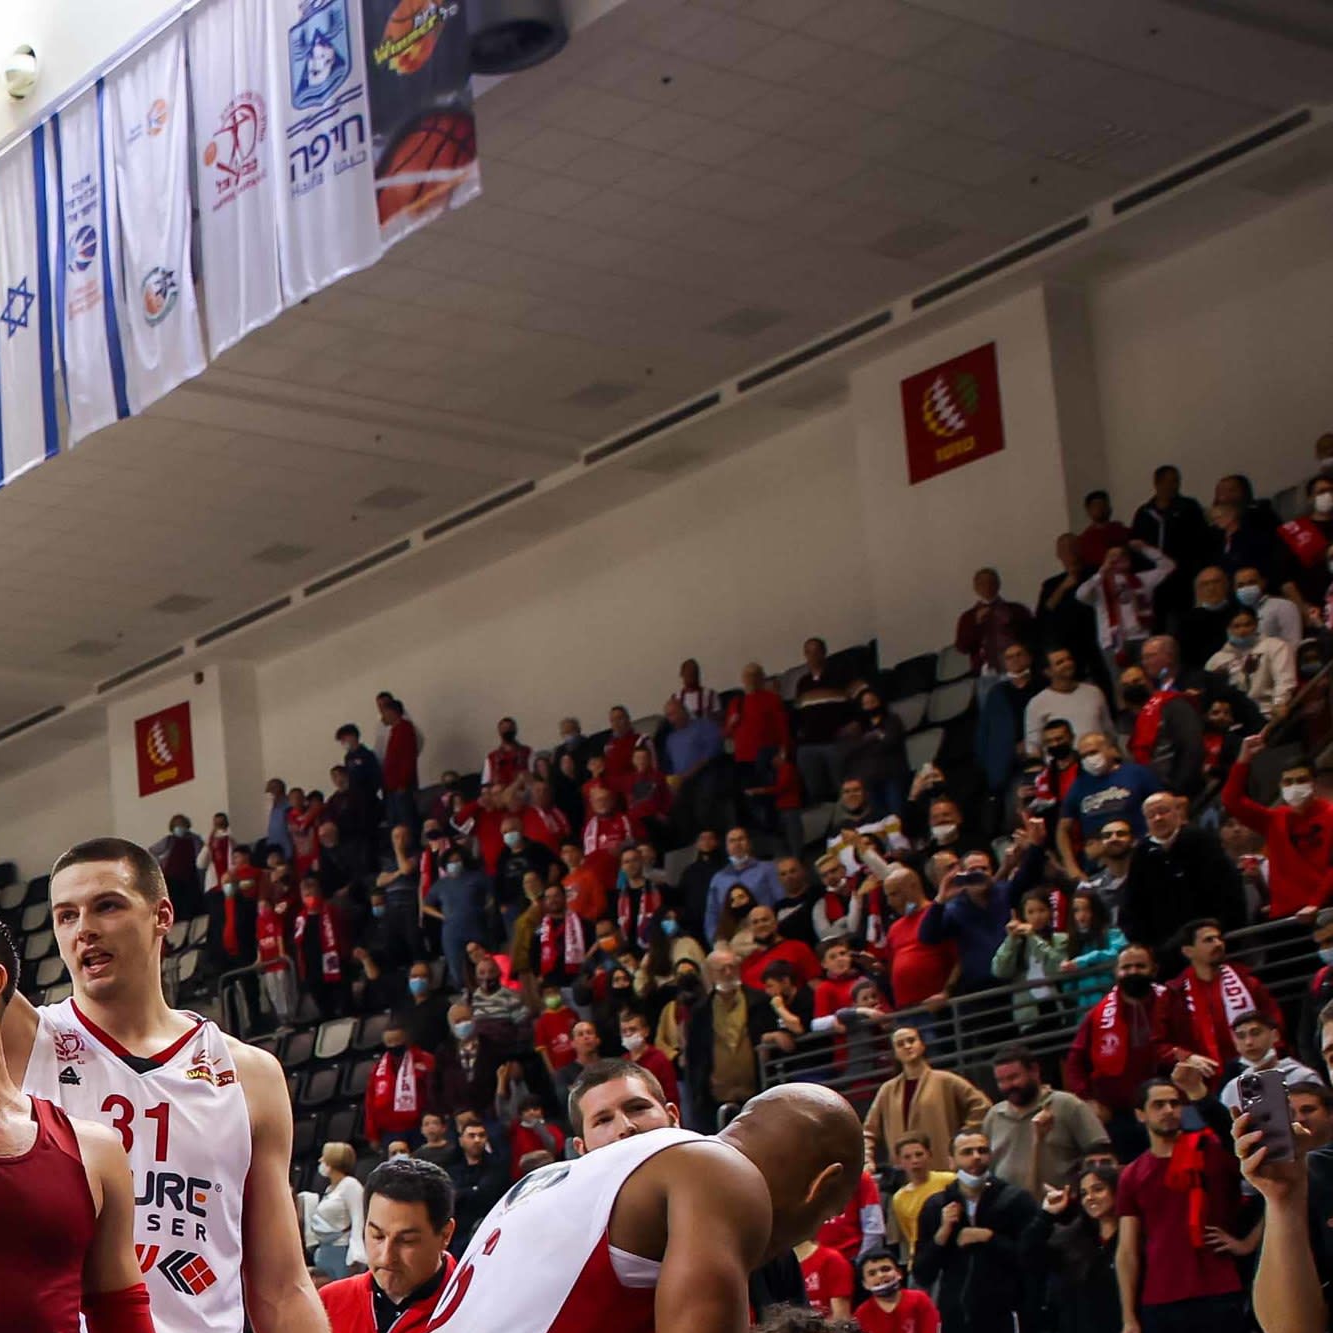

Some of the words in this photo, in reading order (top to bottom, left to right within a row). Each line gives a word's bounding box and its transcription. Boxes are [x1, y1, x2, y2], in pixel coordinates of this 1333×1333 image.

[290, 114, 364, 183] חיפה
[101, 1094, 170, 1162] 31
[135, 1171, 211, 1217] URE
[147, 1214, 207, 1242] SER
